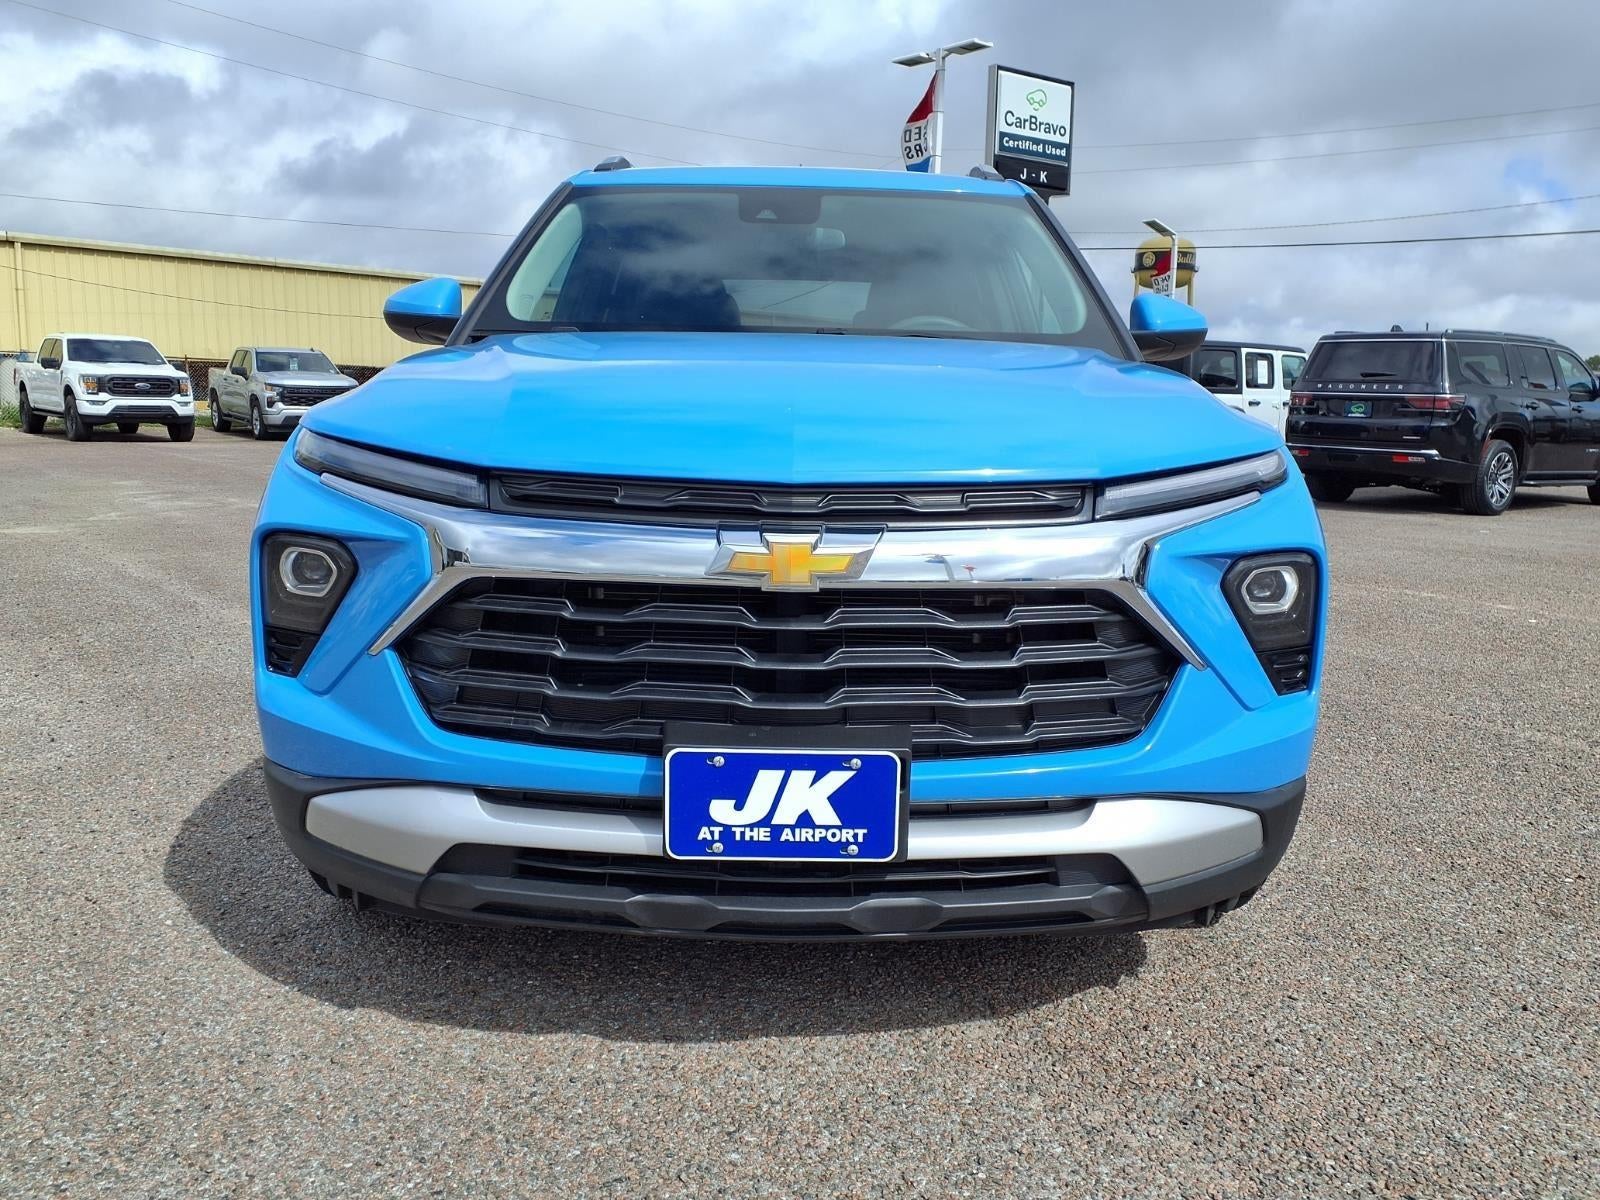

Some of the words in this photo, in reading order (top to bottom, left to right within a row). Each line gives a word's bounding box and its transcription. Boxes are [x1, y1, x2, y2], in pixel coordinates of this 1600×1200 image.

[1004, 110, 1067, 137] CarBravo
[1003, 137, 1043, 153] Certified
[1044, 144, 1067, 157] Used
[709, 769, 857, 826] JK
[697, 826, 723, 841] AT
[731, 826, 771, 842] THE
[779, 827, 868, 844] AIRPORT
